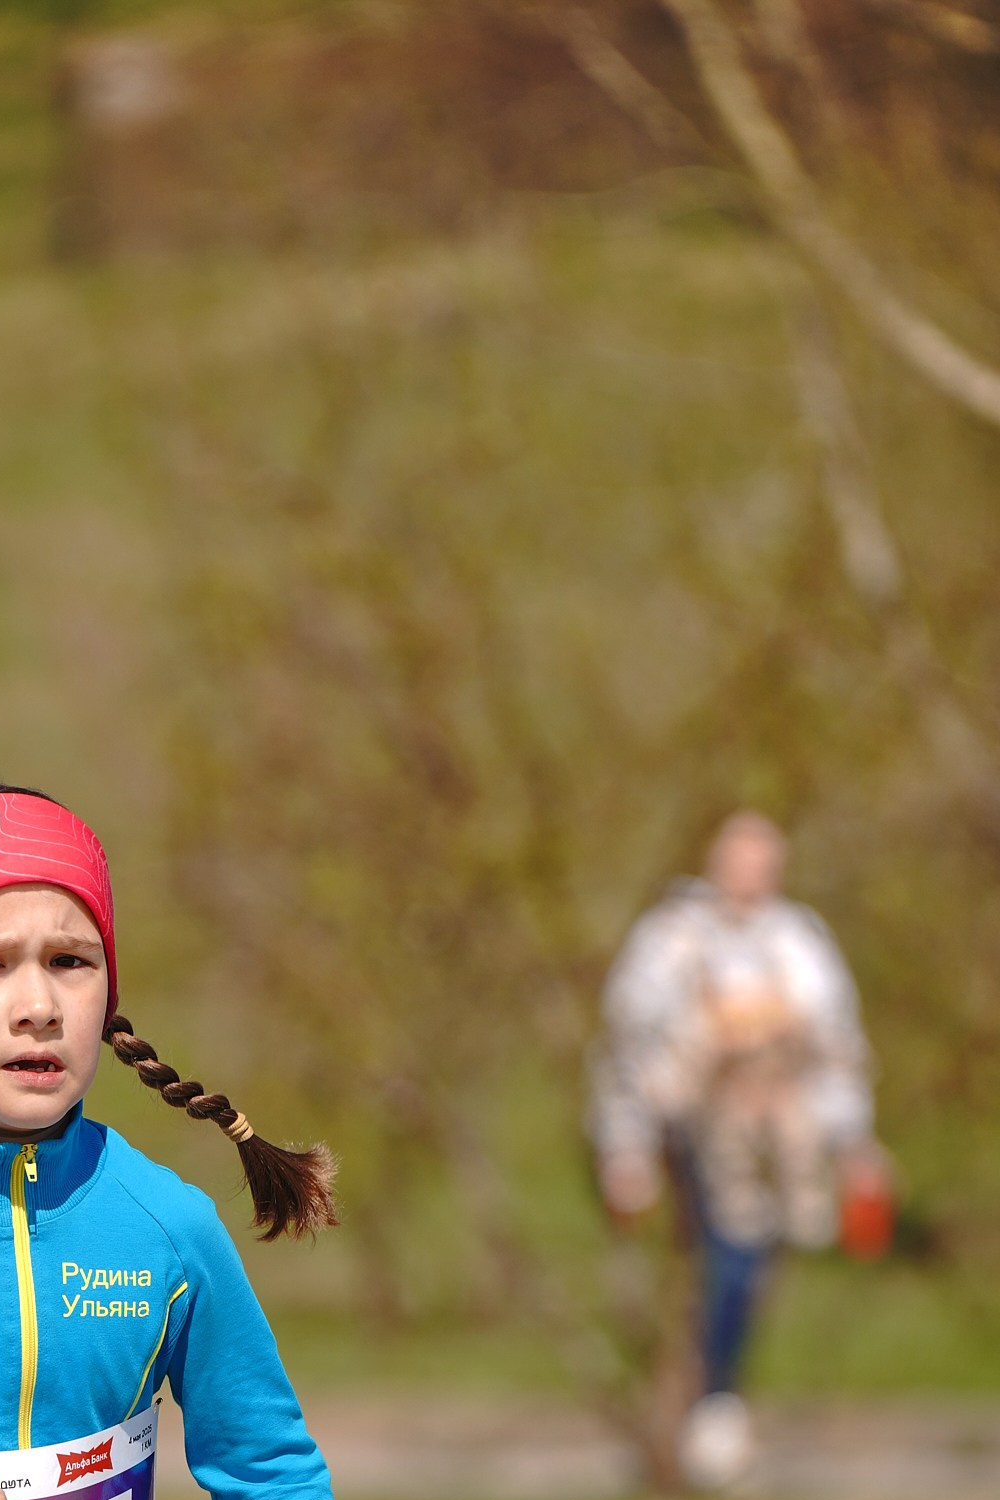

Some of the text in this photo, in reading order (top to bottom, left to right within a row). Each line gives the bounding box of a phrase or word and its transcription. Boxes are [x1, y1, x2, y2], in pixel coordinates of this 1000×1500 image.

[62, 1262, 152, 1290] Рудина
[62, 1294, 150, 1318] Ульяна
[65, 1452, 108, 1474] Альфа Банк
